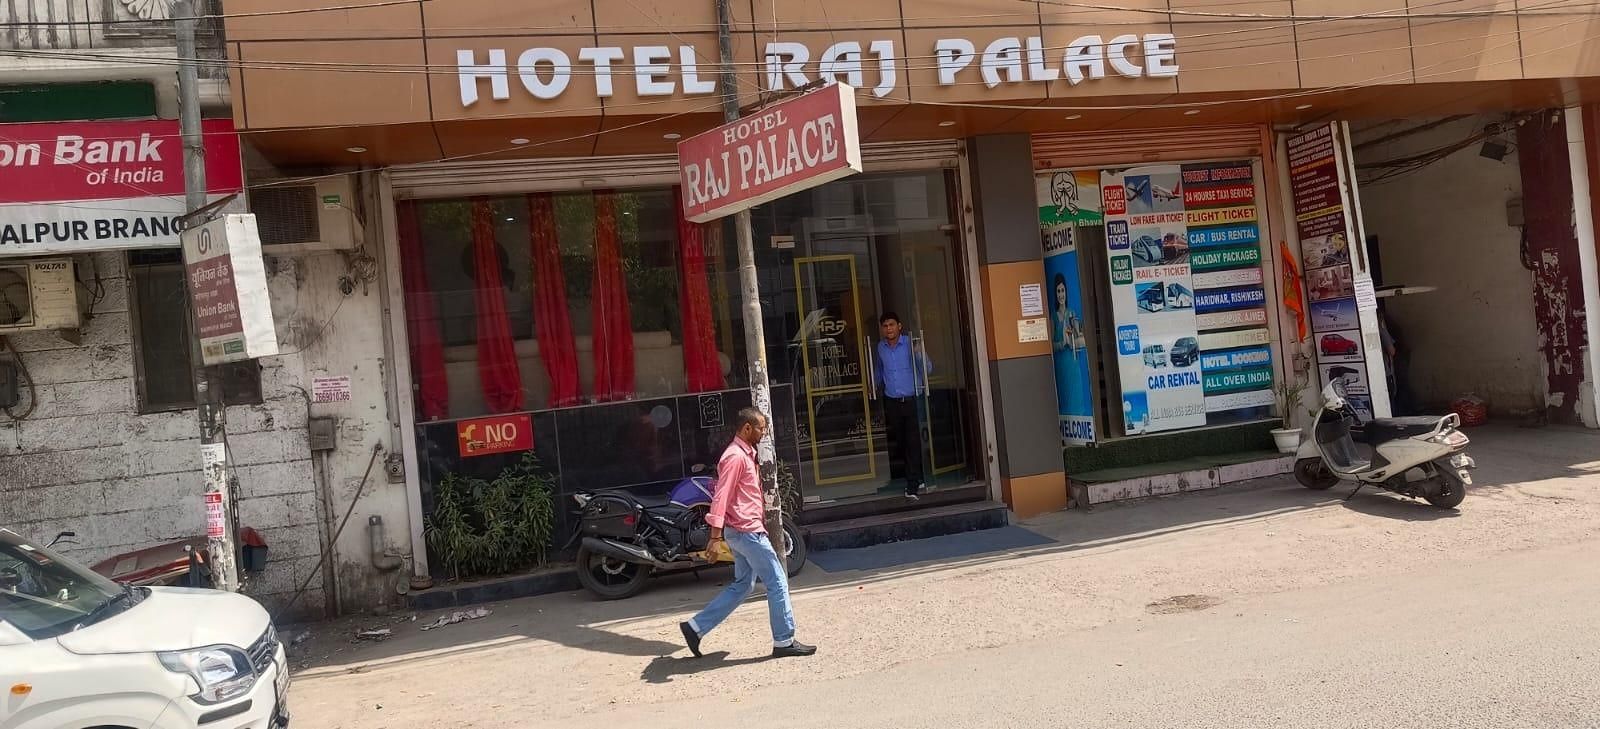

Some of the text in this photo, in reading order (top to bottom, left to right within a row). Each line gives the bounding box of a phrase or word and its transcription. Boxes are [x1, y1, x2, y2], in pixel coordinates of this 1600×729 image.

[457, 33, 1180, 107] HOTEL RAJ PALACE
[722, 110, 788, 146] HOTEL
[53, 133, 164, 165] Bank
[685, 113, 838, 208] RAJ PALACE
[86, 167, 164, 185] of India
[1104, 189, 1124, 200] FLIGHT
[1230, 187, 1254, 199] SERVICE
[1106, 200, 1125, 210] TICKET
[1142, 215, 1155, 224] FARE
[1156, 214, 1165, 223] AIR
[1166, 213, 1184, 222] TICKET
[1187, 208, 1255, 222] FLIGHT TICKET
[1109, 223, 1126, 234] TRAIN
[1190, 233, 1206, 244] CAR
[1211, 231, 1227, 242] BUS
[1228, 228, 1257, 240] RENTAL
[1109, 234, 1128, 245] TICKET
[1192, 249, 1258, 265] HOLIDAY PACKAGES
[35, 262, 67, 270] VOLTAS
[1136, 270, 1153, 279] RAIL
[1163, 266, 1189, 277] TICKET
[1231, 290, 1264, 303] RISHIKESH
[198, 305, 217, 318] Union
[217, 300, 235, 314] Bank
[821, 344, 848, 360] HOTEL
[1203, 355, 1230, 368] HOTEL
[828, 362, 859, 379] PALACE
[1148, 371, 1200, 389] CAR RENTAL
[1206, 371, 1270, 388] ALL OVER INDIA
[485, 422, 517, 443] NO
